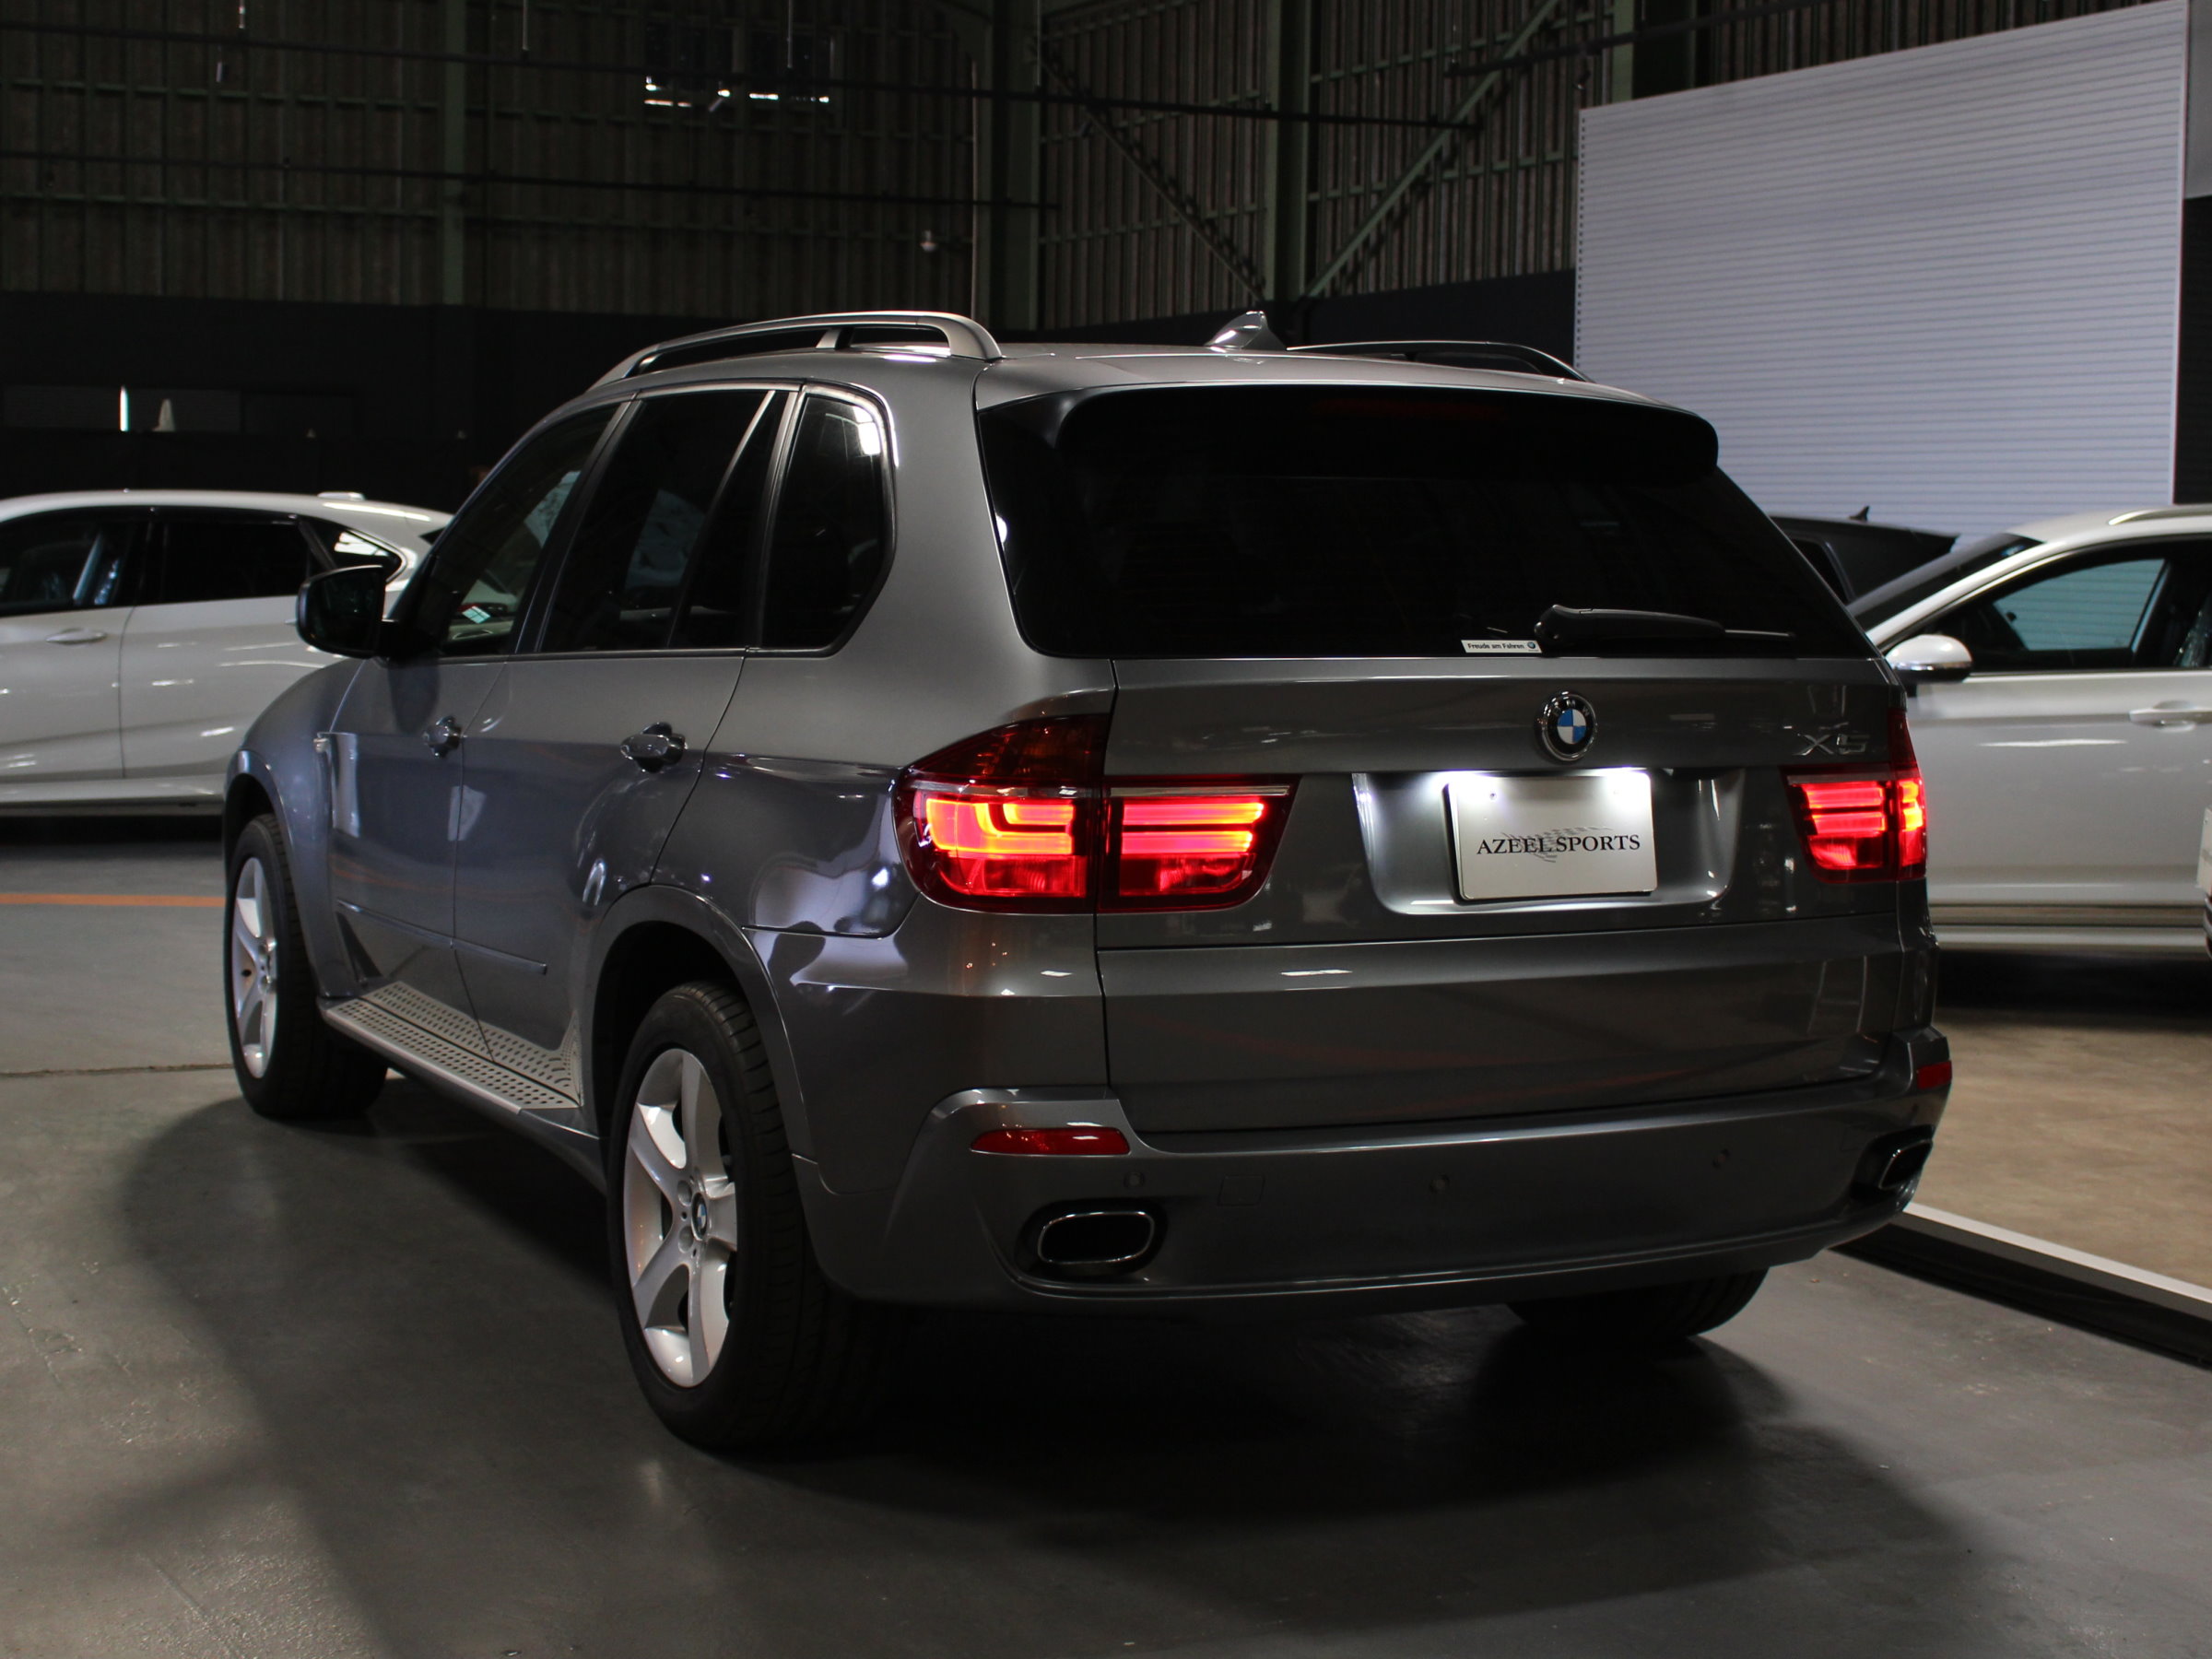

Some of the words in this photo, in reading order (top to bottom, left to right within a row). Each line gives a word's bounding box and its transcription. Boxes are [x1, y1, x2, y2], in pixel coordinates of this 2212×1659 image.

[1793, 733, 1870, 756] X5
[1477, 838, 1553, 854] AZEEL
[1555, 834, 1641, 853] SPORTS
